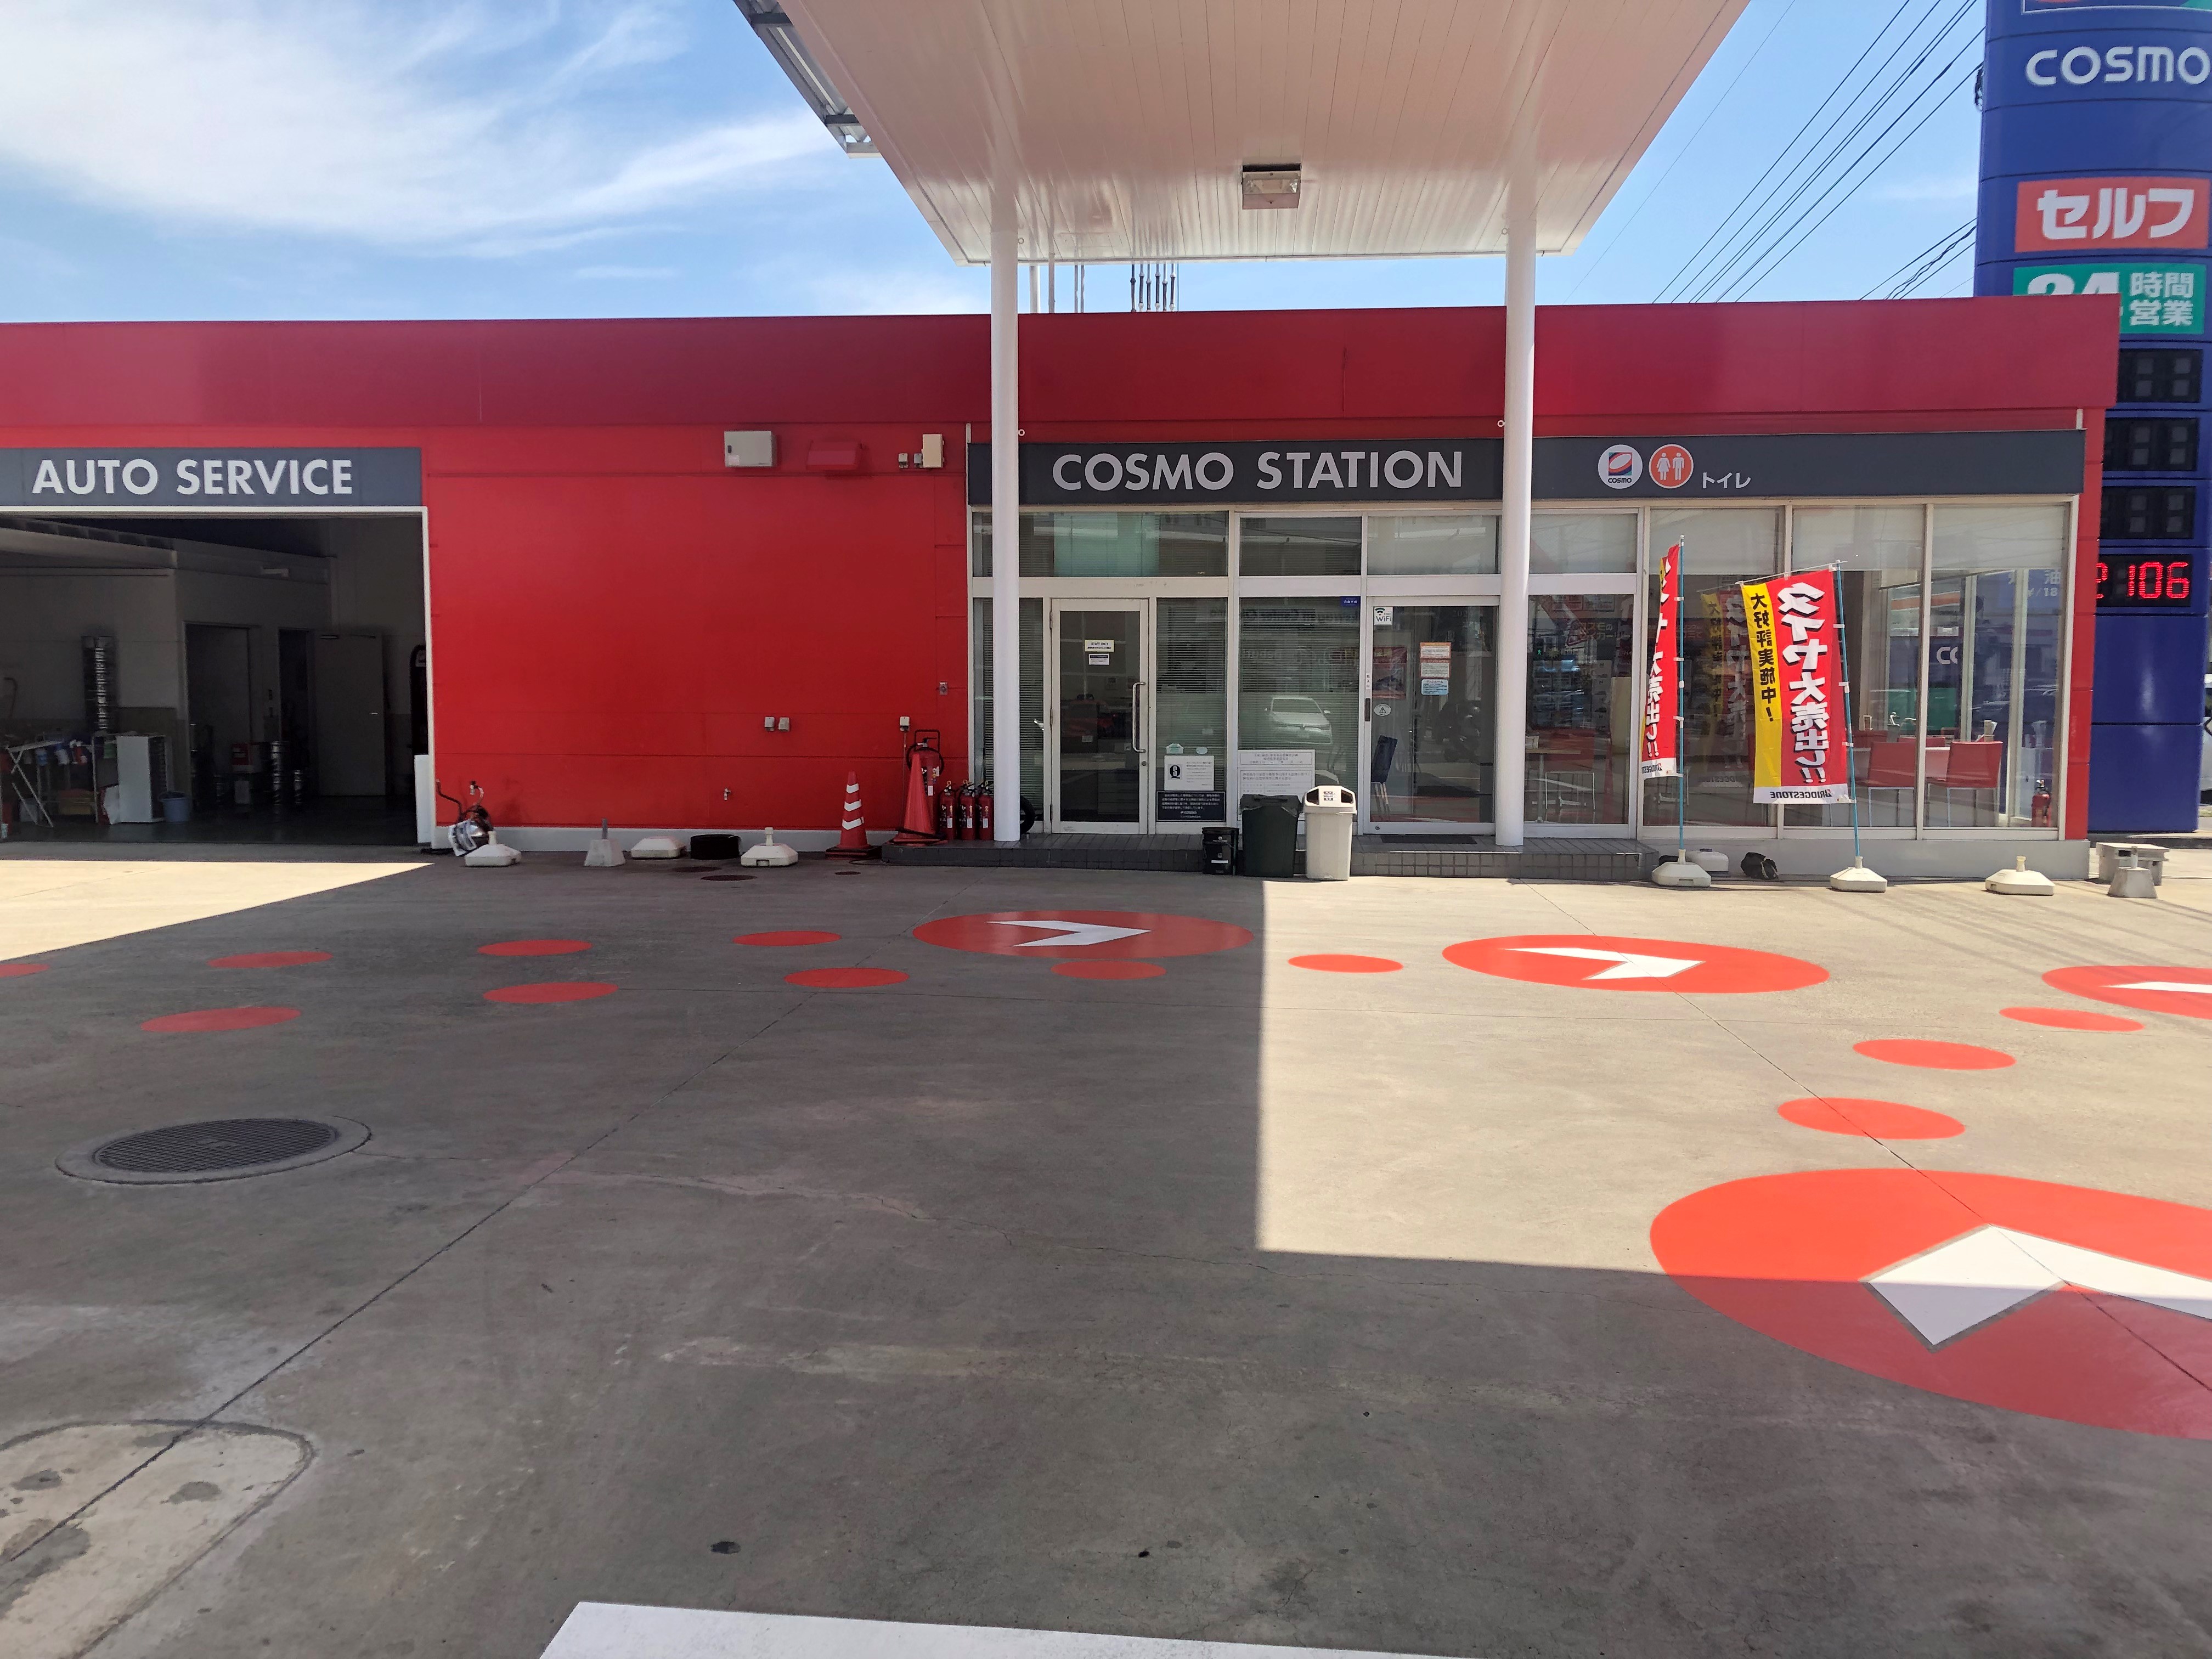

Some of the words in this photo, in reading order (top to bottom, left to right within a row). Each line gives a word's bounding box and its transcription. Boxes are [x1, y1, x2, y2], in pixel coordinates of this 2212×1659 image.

[2025, 46, 2211, 85] COSMO
[2036, 187, 2195, 240] セルフ
[2129, 271, 2194, 298] 時間
[2129, 299, 2194, 326] 営業
[31, 458, 159, 495] AUTO
[176, 458, 353, 495] SERVICE
[1052, 452, 1234, 492] COSMO
[1256, 450, 1463, 490] STATION
[1702, 471, 1752, 489] トイレ
